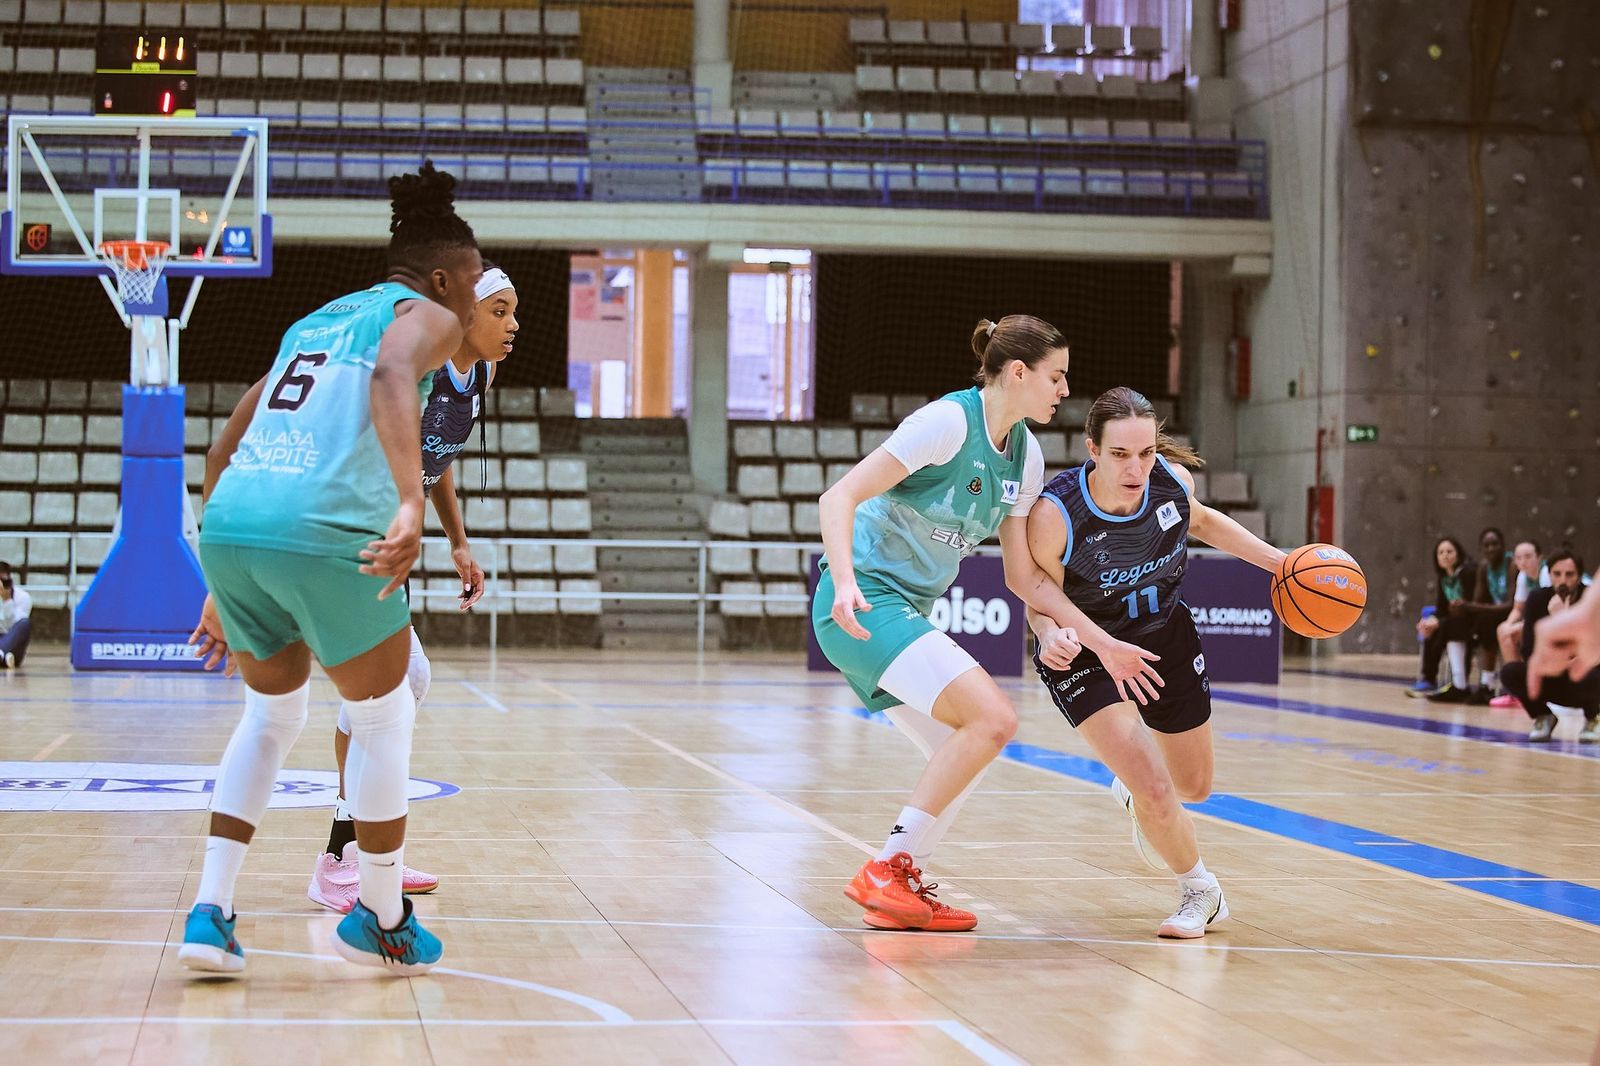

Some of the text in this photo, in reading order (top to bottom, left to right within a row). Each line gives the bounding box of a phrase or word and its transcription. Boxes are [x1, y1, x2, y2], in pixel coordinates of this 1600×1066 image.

[267, 352, 328, 412] 6
[1121, 585, 1160, 619] 11
[1208, 607, 1273, 625] SORIANO
